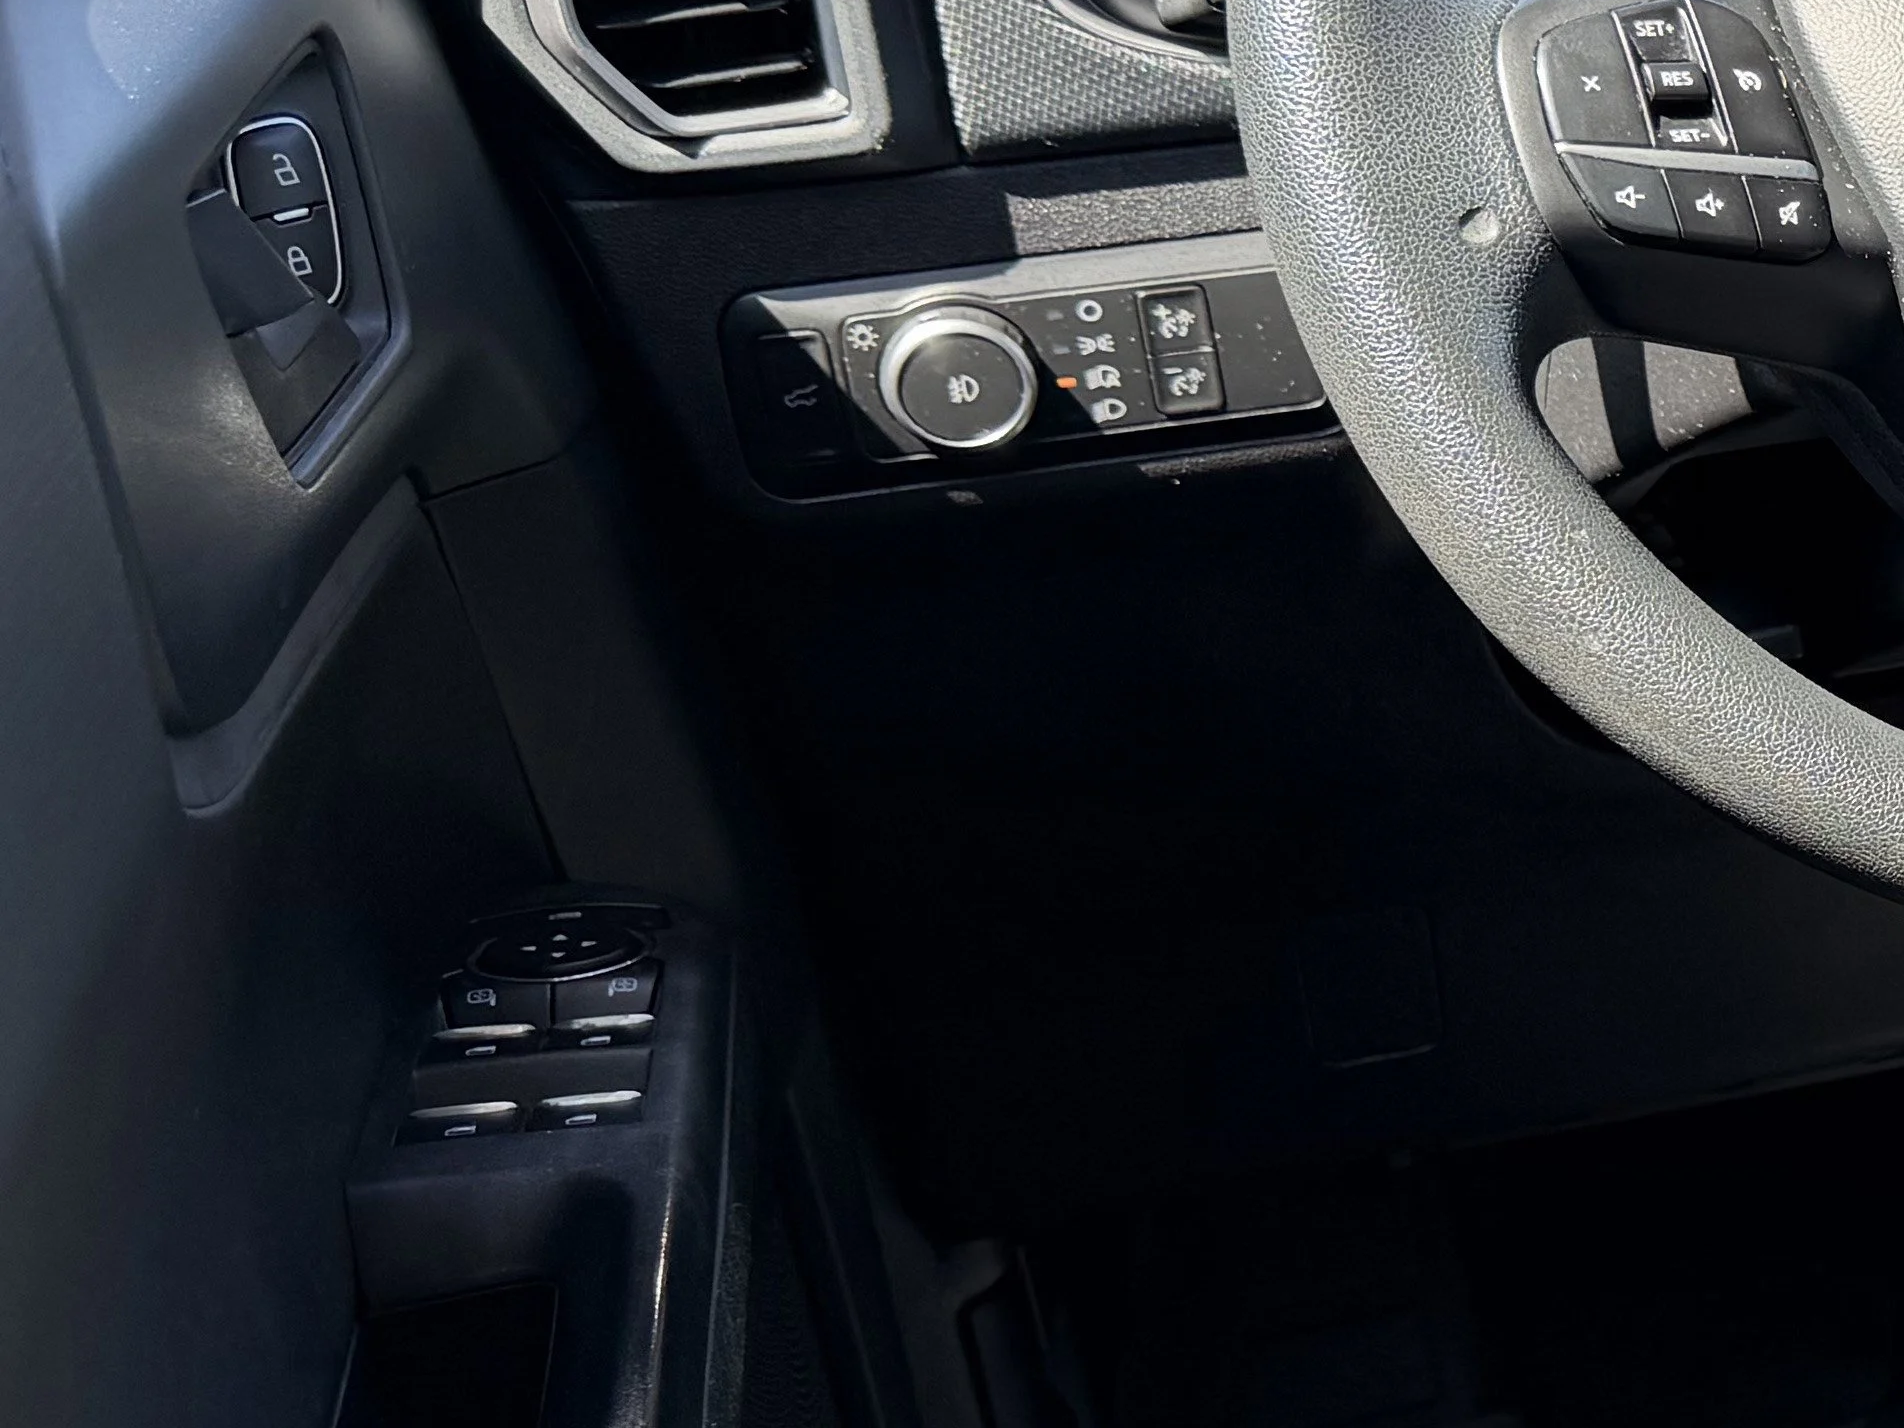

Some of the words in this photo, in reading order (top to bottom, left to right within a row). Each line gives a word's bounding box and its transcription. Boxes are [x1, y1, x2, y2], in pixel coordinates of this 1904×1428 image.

[1633, 19, 1675, 38] SET+
[1660, 71, 1694, 87] RES
[1668, 128, 1711, 143] SET-
